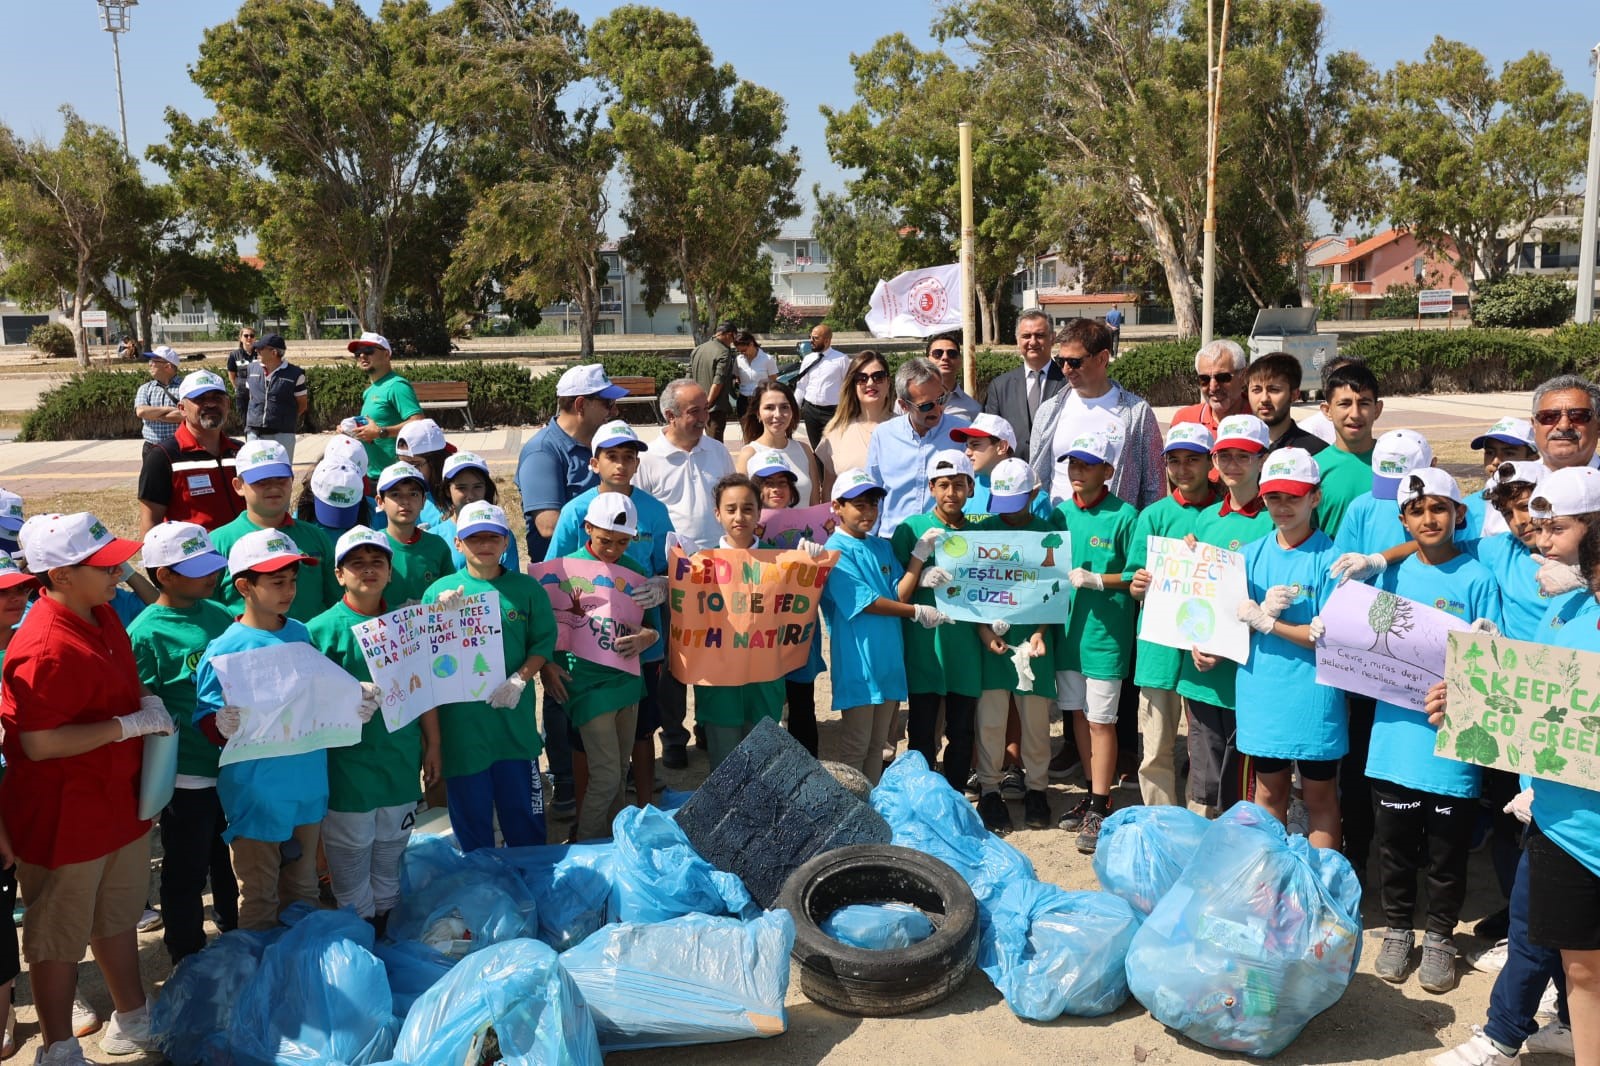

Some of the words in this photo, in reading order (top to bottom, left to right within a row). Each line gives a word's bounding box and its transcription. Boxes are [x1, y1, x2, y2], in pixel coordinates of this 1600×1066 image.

[978, 544, 1020, 562] DOĞA
[1153, 577, 1217, 597] NATURE
[671, 588, 686, 613] E
[697, 591, 725, 614] TO
[732, 592, 764, 614] BE
[773, 594, 810, 614] FED
[967, 587, 1018, 605] GÜZEL
[392, 608, 423, 624] CLEAN
[429, 614, 443, 624] RE
[460, 606, 490, 617] TREES
[378, 618, 387, 629] A
[399, 620, 413, 635] AIR
[428, 619, 453, 633] MAKE
[460, 618, 481, 627] NOT
[362, 632, 387, 648] BIKE
[400, 625, 426, 645] CLEAN
[430, 632, 457, 644] WORL
[463, 636, 485, 647] ORS
[671, 624, 722, 648] WITH
[733, 622, 814, 648] NATURE
[366, 644, 387, 658] NOT
[390, 640, 398, 651] A
[432, 645, 439, 654] D
[376, 652, 399, 669] CAR
[1491, 672, 1561, 705] KEEP
[1481, 710, 1516, 736] GO
[531, 790, 543, 815] REAL
